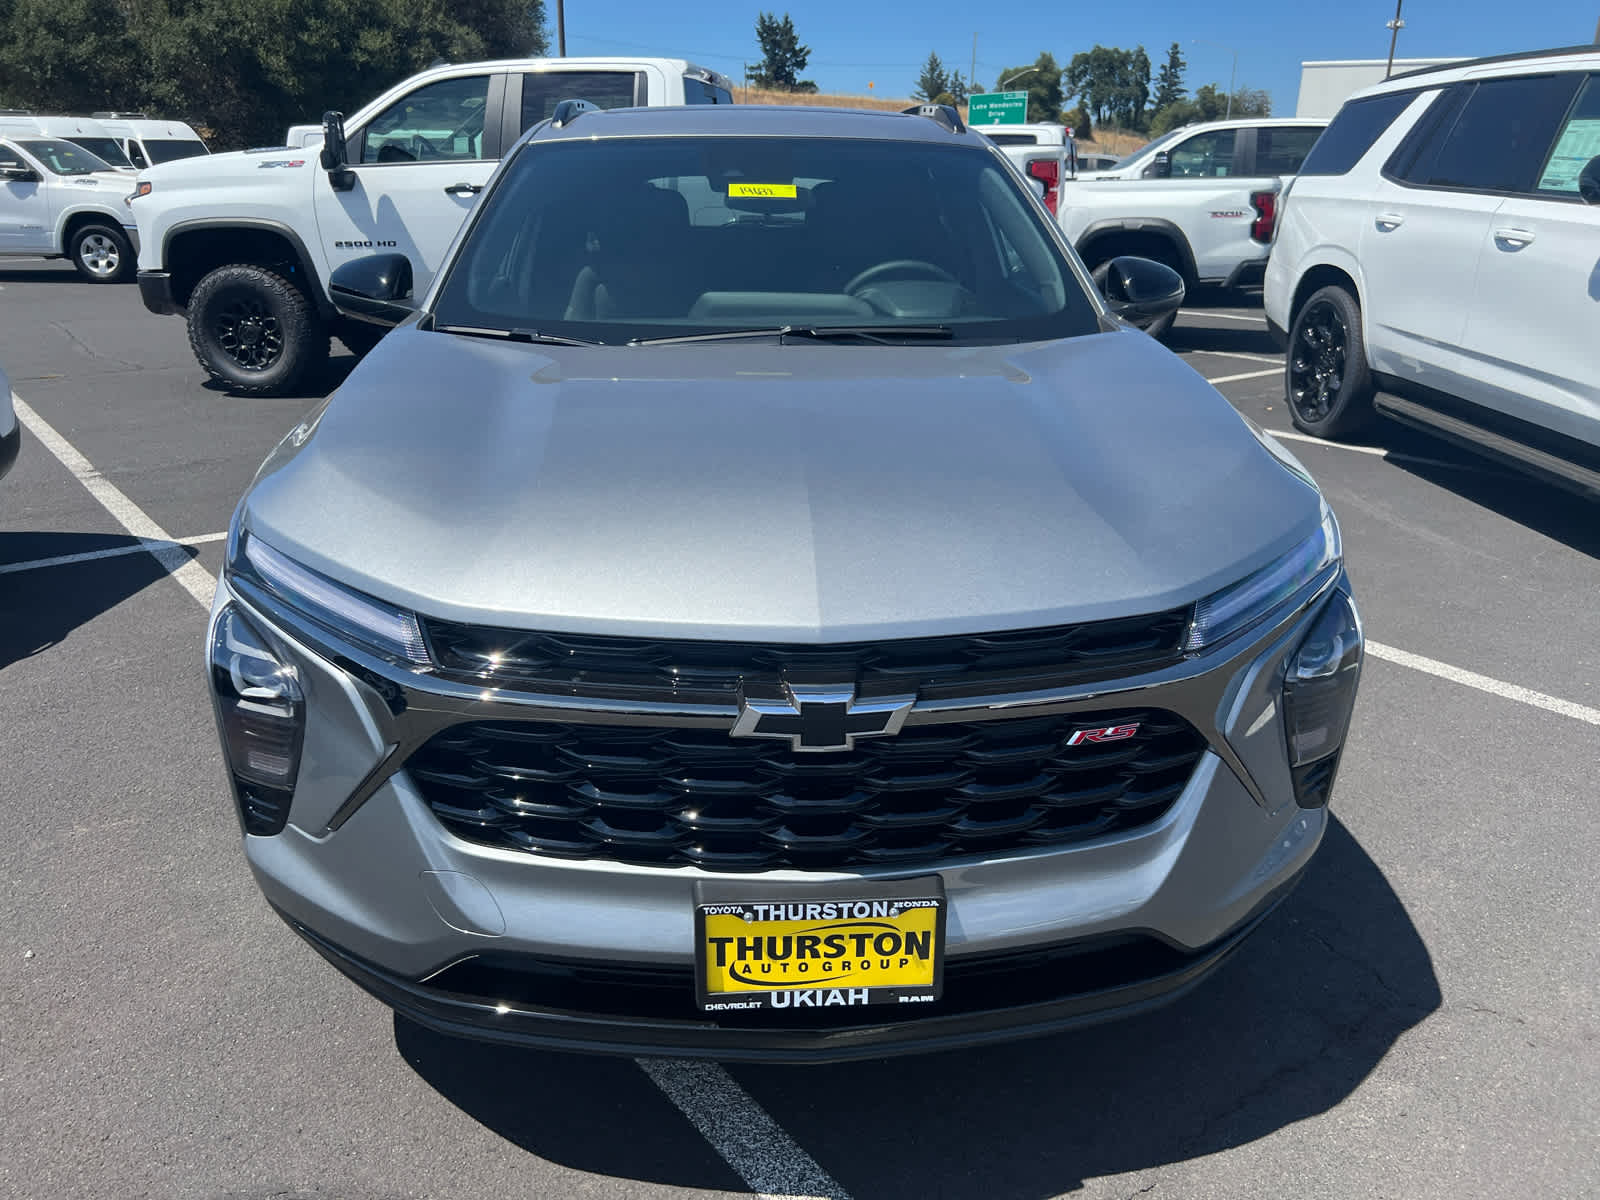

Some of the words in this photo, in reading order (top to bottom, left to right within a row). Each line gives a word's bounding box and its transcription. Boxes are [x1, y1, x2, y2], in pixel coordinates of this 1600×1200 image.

[1066, 722, 1140, 745] RS
[703, 906, 744, 915] TOYOTA
[753, 901, 888, 921] THURSTON
[894, 900, 939, 908] HONDA
[708, 930, 931, 967] THURSTON
[742, 962, 809, 974] AUTO
[822, 958, 909, 972] GROUP
[705, 1001, 763, 1011] CHEVROLET
[771, 988, 869, 1008] UKIAH
